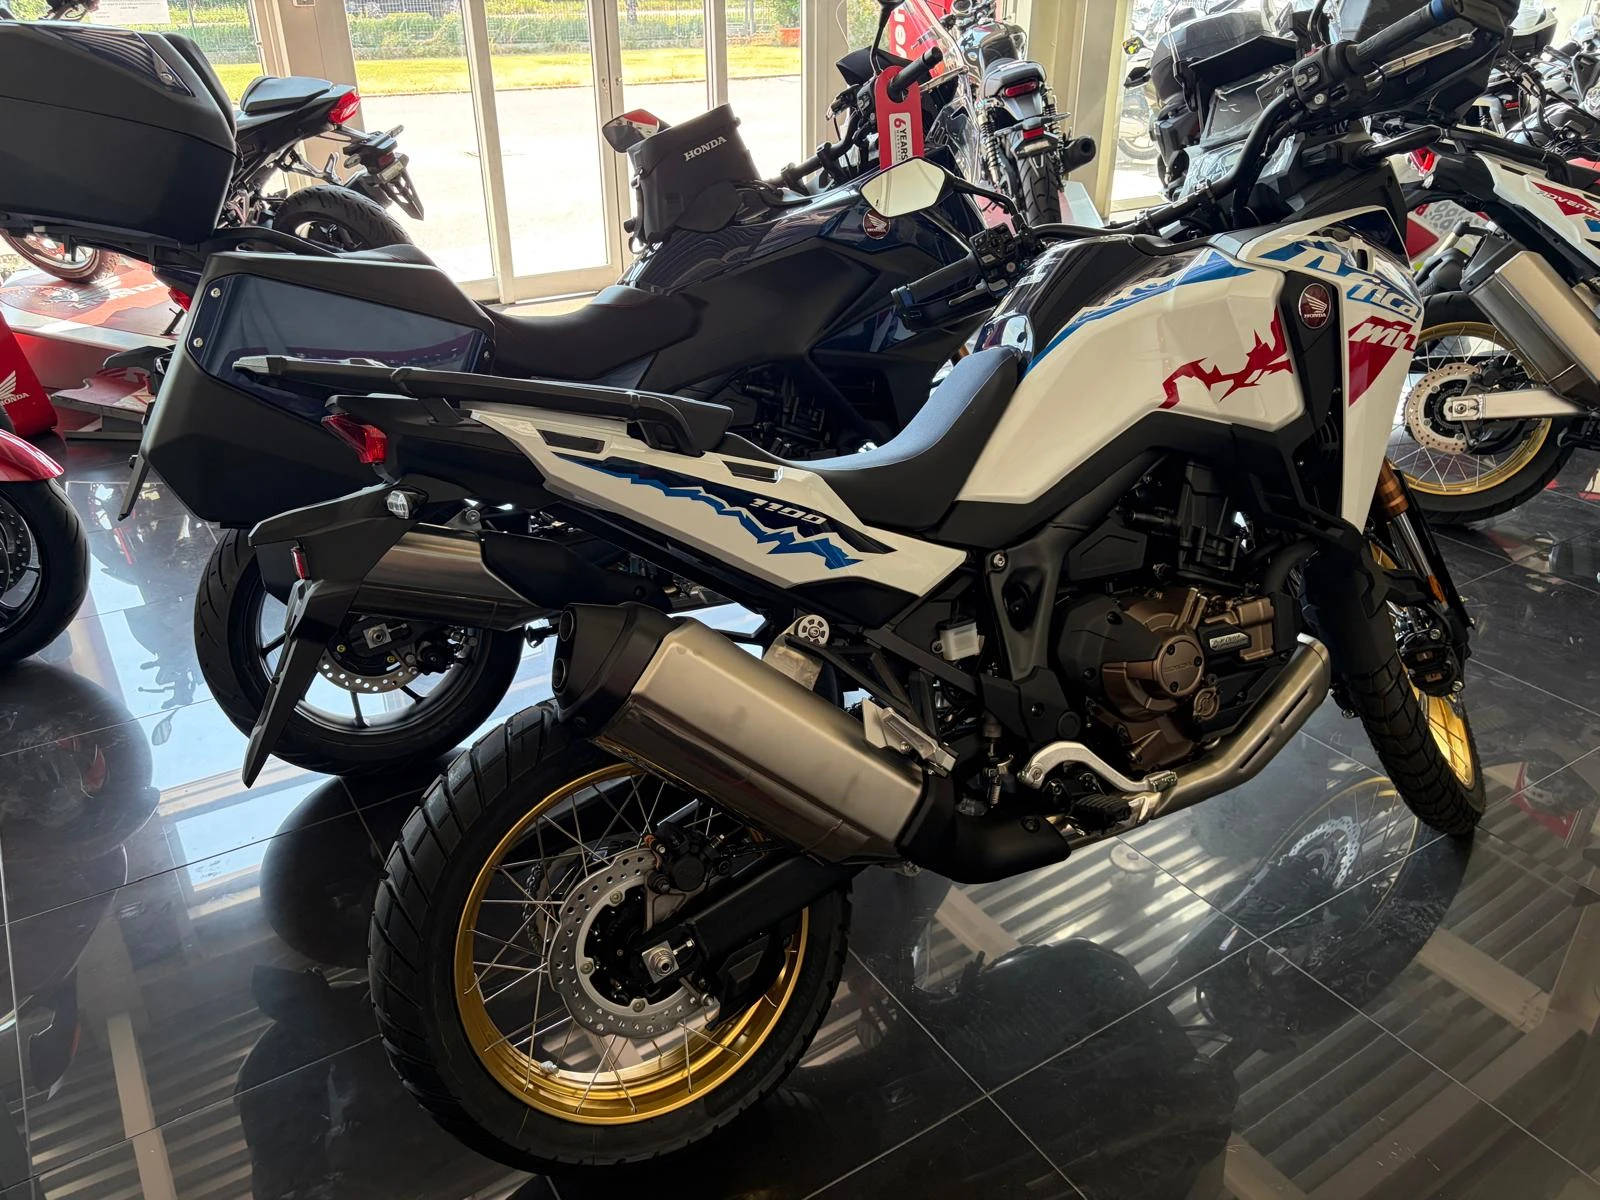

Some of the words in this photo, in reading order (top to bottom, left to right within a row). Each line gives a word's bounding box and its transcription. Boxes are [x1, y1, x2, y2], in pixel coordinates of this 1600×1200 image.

[683, 136, 727, 161] HONDA
[894, 118, 906, 128] 6
[900, 128, 908, 160] YEARS
[750, 498, 827, 524] 1100
